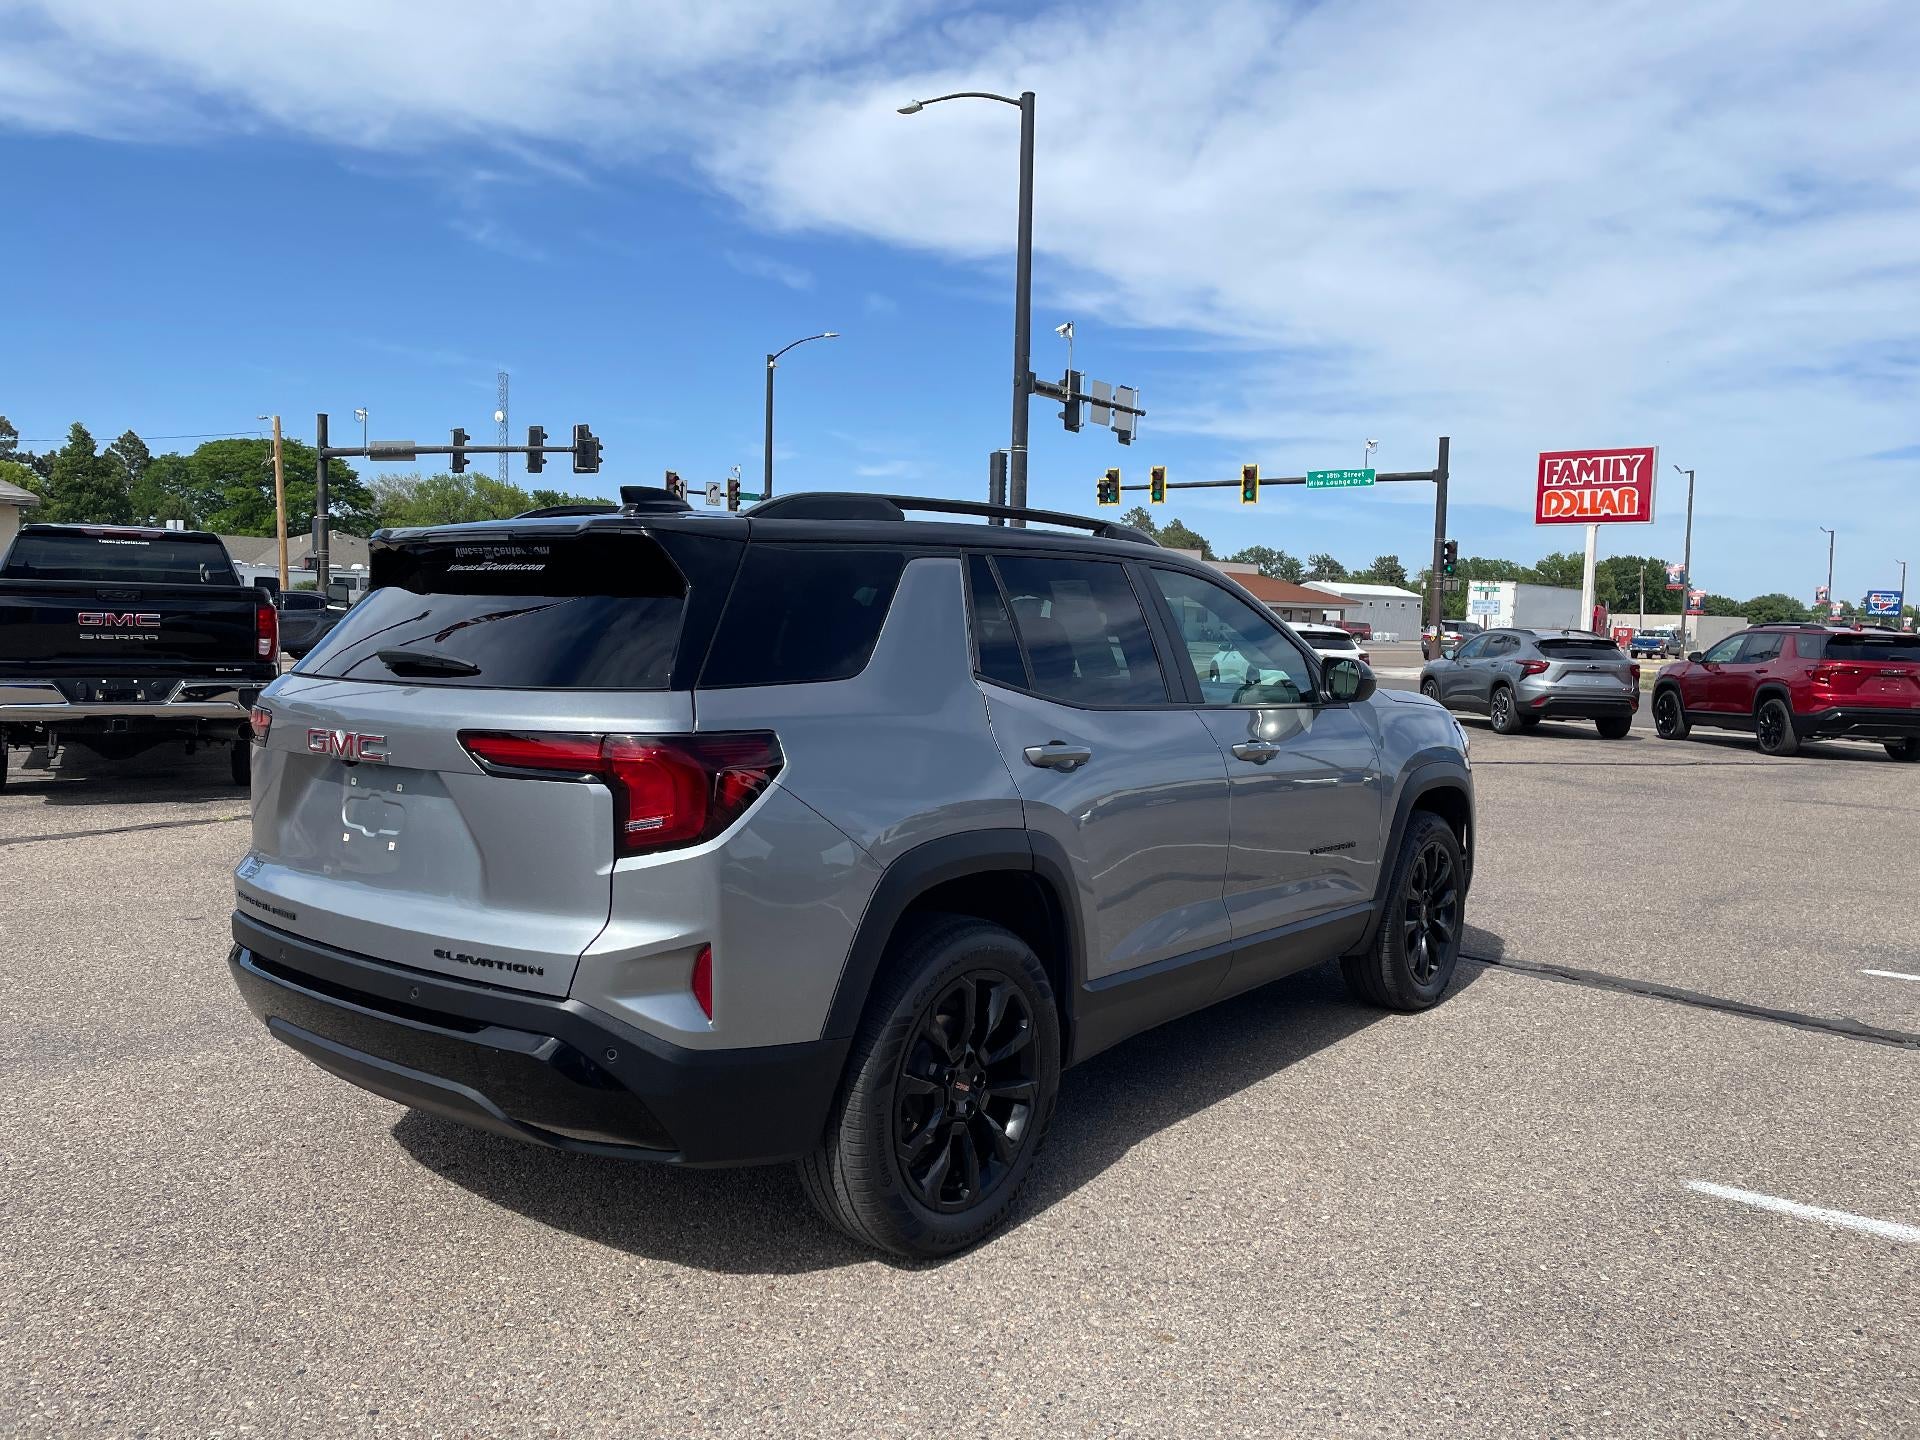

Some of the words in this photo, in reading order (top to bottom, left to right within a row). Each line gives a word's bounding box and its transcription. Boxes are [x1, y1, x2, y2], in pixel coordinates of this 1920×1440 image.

[1326, 478, 1351, 487] Lounge
[1343, 470, 1365, 478] Street
[1544, 455, 1645, 486] FAMILY
[1542, 487, 1639, 517] DOLLAR
[78, 612, 161, 627] GMC
[307, 727, 391, 764] GMC
[433, 948, 544, 976] ELEVATION
